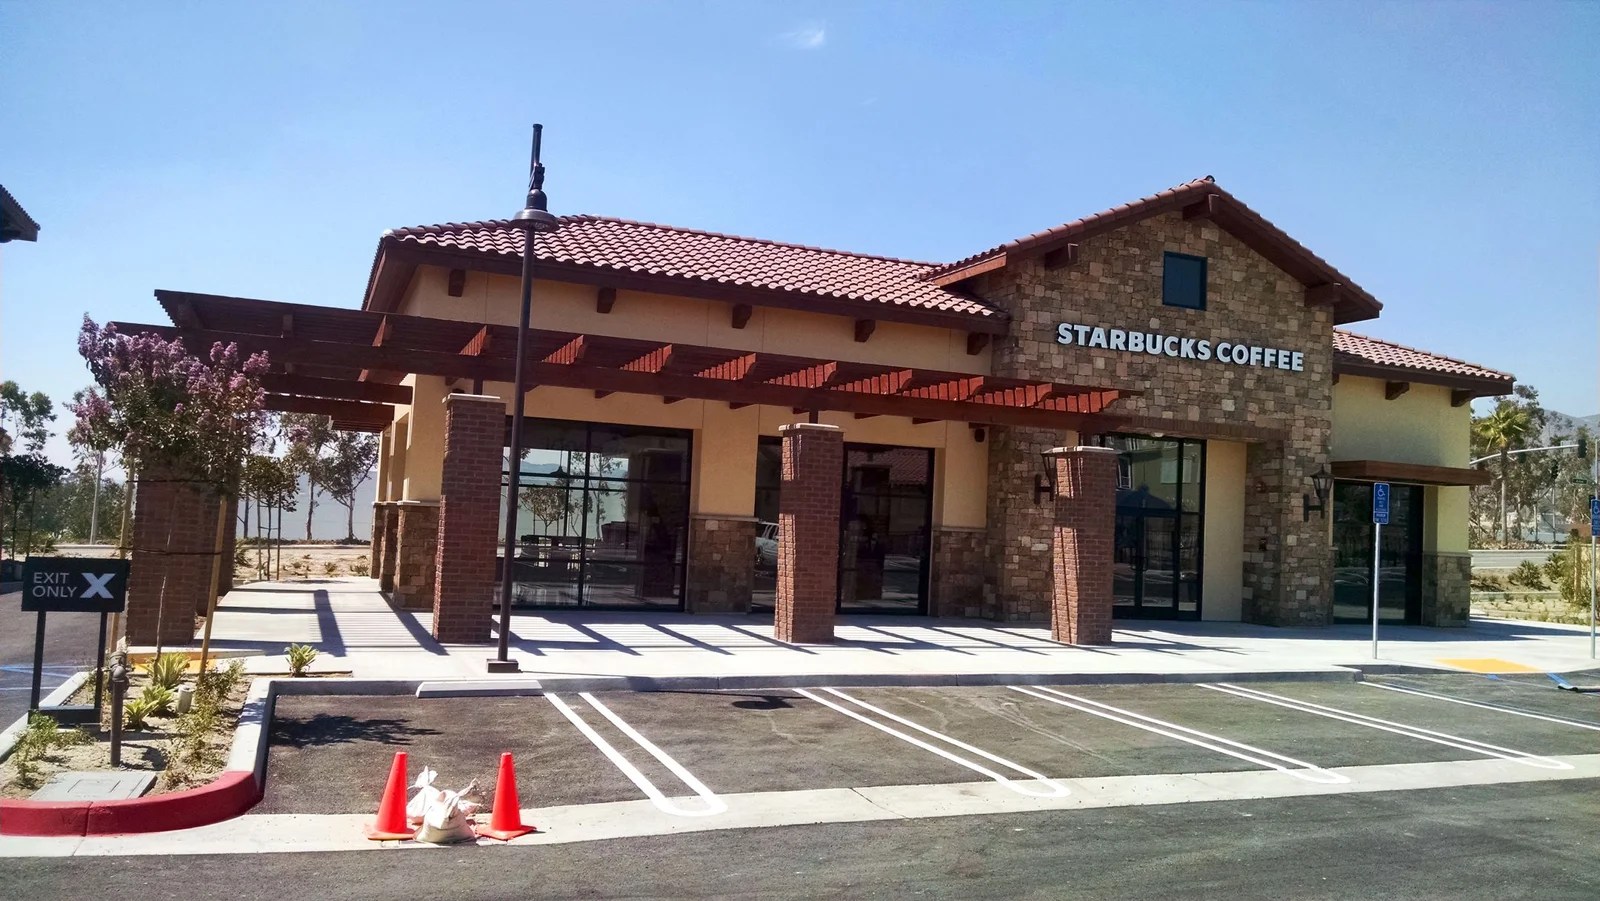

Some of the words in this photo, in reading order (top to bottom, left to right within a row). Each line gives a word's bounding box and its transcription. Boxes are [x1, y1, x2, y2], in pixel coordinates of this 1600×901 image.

[1057, 322, 1211, 361] STARBUCKS
[1216, 342, 1304, 371] COFFEE
[33, 572, 70, 584] EXIT
[80, 572, 116, 598] X
[32, 585, 77, 598] ONLY
